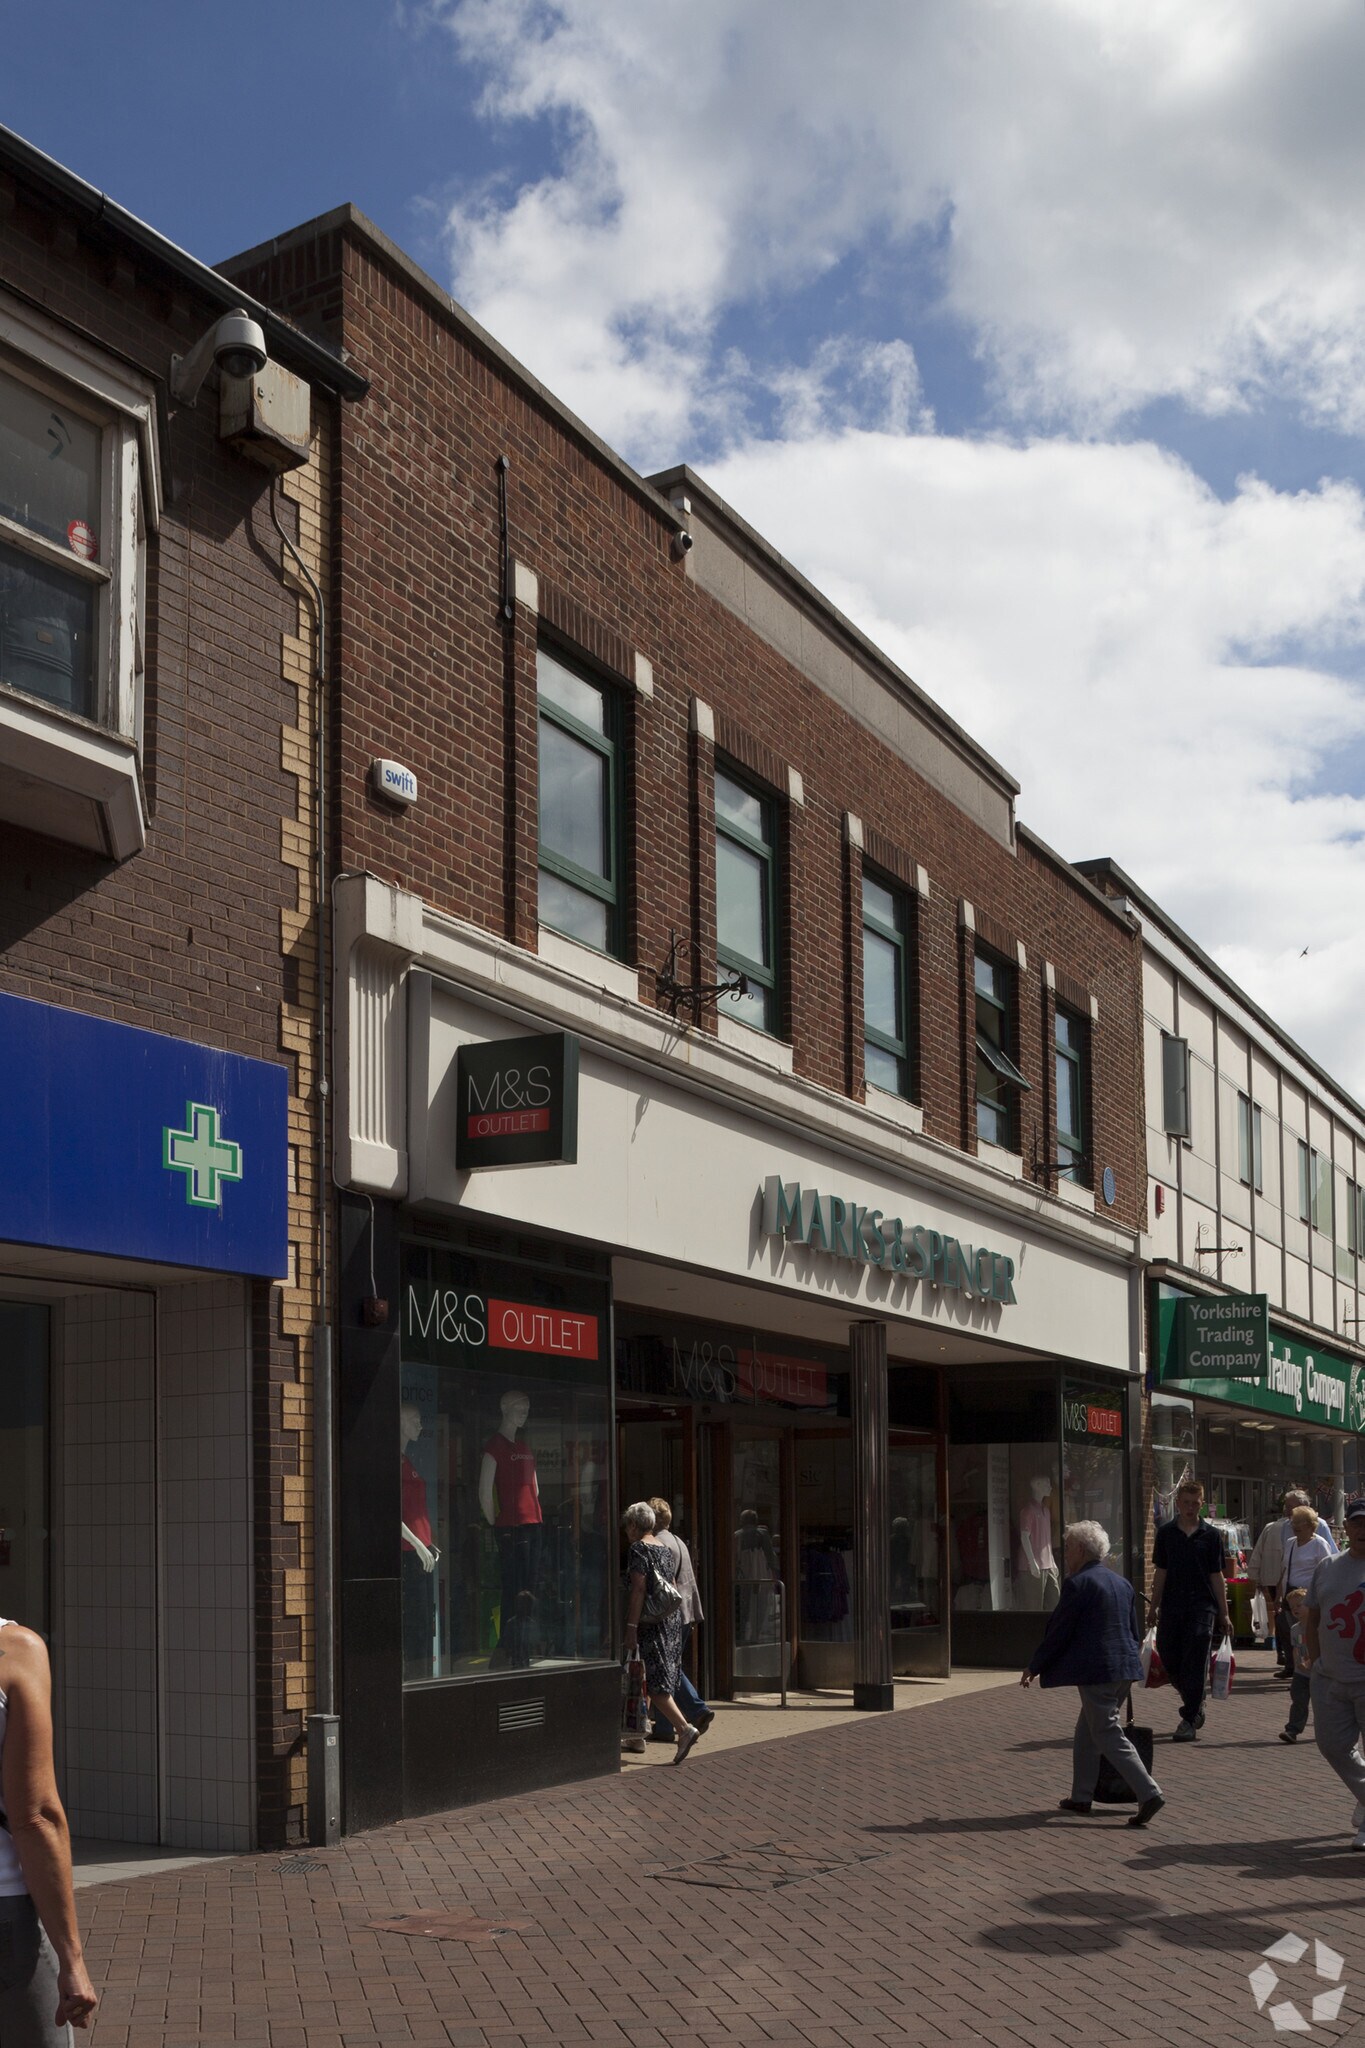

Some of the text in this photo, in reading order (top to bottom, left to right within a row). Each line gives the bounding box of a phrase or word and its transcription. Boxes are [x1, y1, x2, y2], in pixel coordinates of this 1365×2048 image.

[385, 769, 414, 794] swift
[467, 1065, 551, 1113] M&S
[477, 1113, 540, 1135] OUTLET
[769, 1175, 885, 1265] MARKS
[907, 1225, 1018, 1306] SPENCER
[408, 1284, 586, 1351] M&S OUTLET
[1189, 1303, 1262, 1321] Yorkshire
[1196, 1326, 1255, 1346] Trading
[672, 1336, 817, 1398] M&S OUTLET
[1189, 1350, 1262, 1370] Company
[1305, 1355, 1346, 1423] Company
[1064, 1401, 1118, 1433] M&S OUTLET
